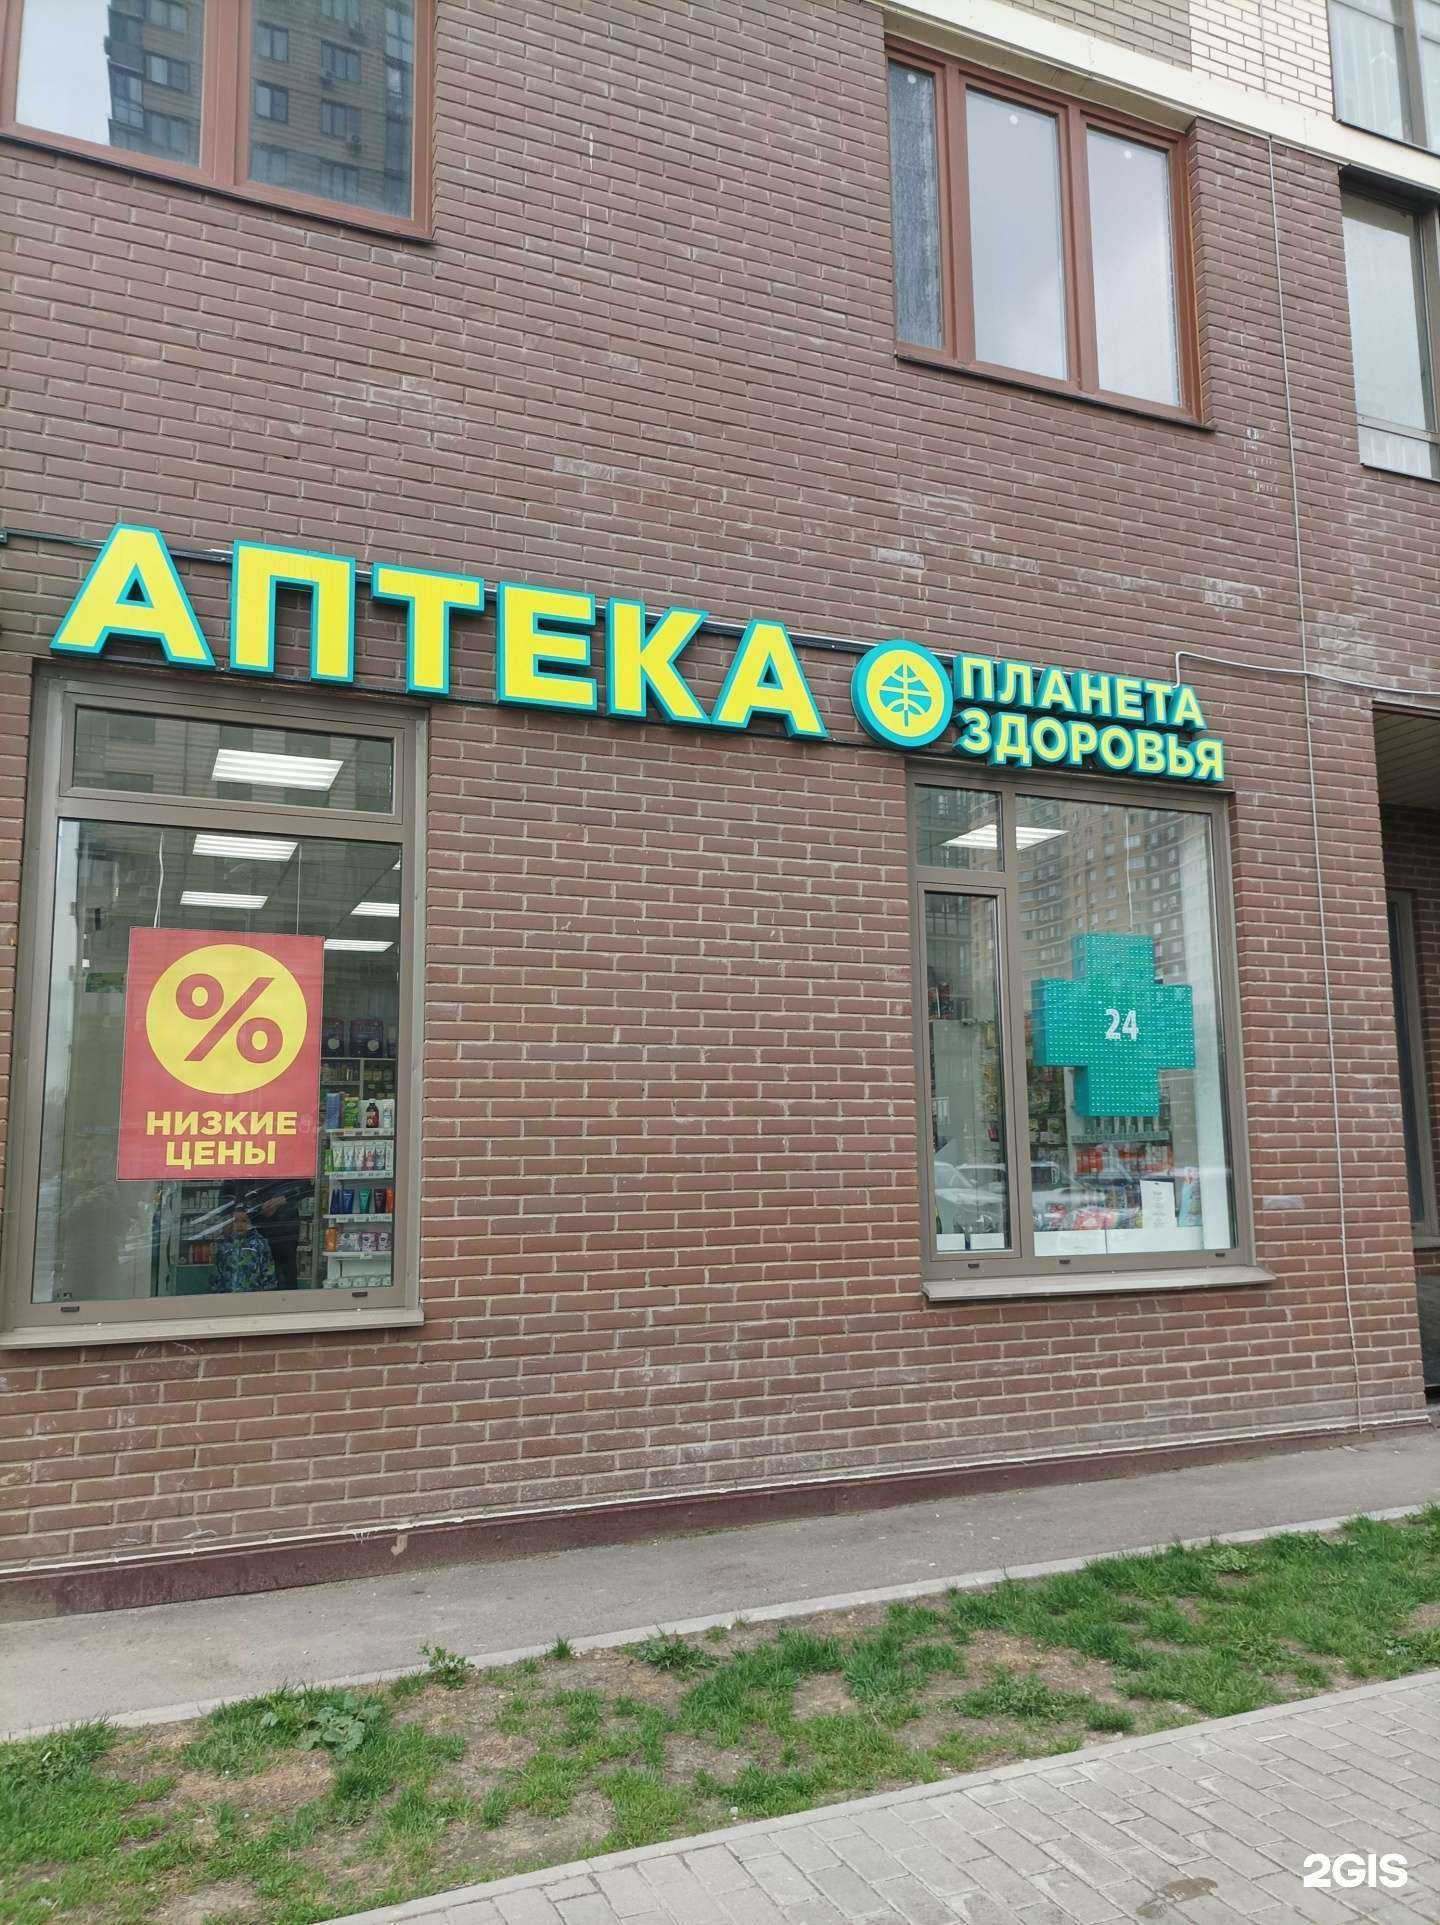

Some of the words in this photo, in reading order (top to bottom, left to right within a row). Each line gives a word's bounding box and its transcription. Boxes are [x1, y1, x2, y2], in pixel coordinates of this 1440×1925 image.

[50, 523, 827, 739] АПТЕКА
[954, 654, 1208, 730] ПЛАНЕТА
[953, 706, 1225, 782] ЗДОРОВЬЯ
[175, 973, 284, 1064] %
[1104, 1008, 1140, 1041] 24
[145, 1110, 298, 1137] НИЗКИЕ
[165, 1140, 277, 1171] ЦЕНЫ
